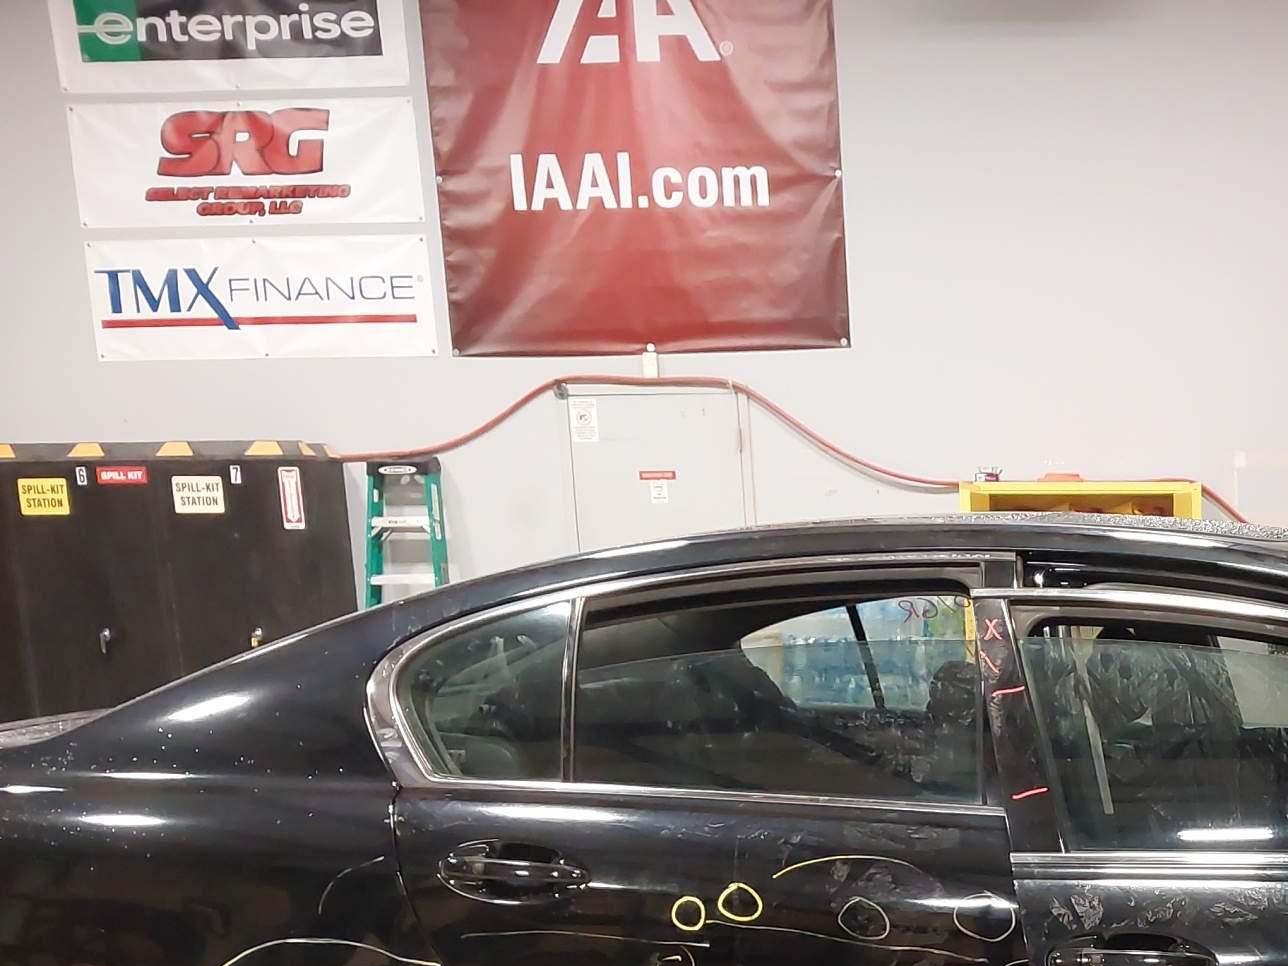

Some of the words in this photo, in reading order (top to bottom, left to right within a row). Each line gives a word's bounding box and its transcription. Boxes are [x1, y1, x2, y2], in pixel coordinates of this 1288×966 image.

[92, 4, 375, 50] enterprise
[157, 107, 330, 177] SRG
[509, 151, 770, 211] IAAI.com
[94, 266, 240, 330] TMX
[228, 274, 416, 302] FINANCE
[78, 468, 86, 483] 6
[100, 471, 127, 480] SPILL
[127, 471, 143, 480] KIT
[231, 466, 240, 483] 7
[21, 483, 66, 495] SPILL-KIT
[175, 481, 221, 493] SPILL-KIT
[26, 496, 64, 508] STATION
[180, 495, 219, 506] STATION
